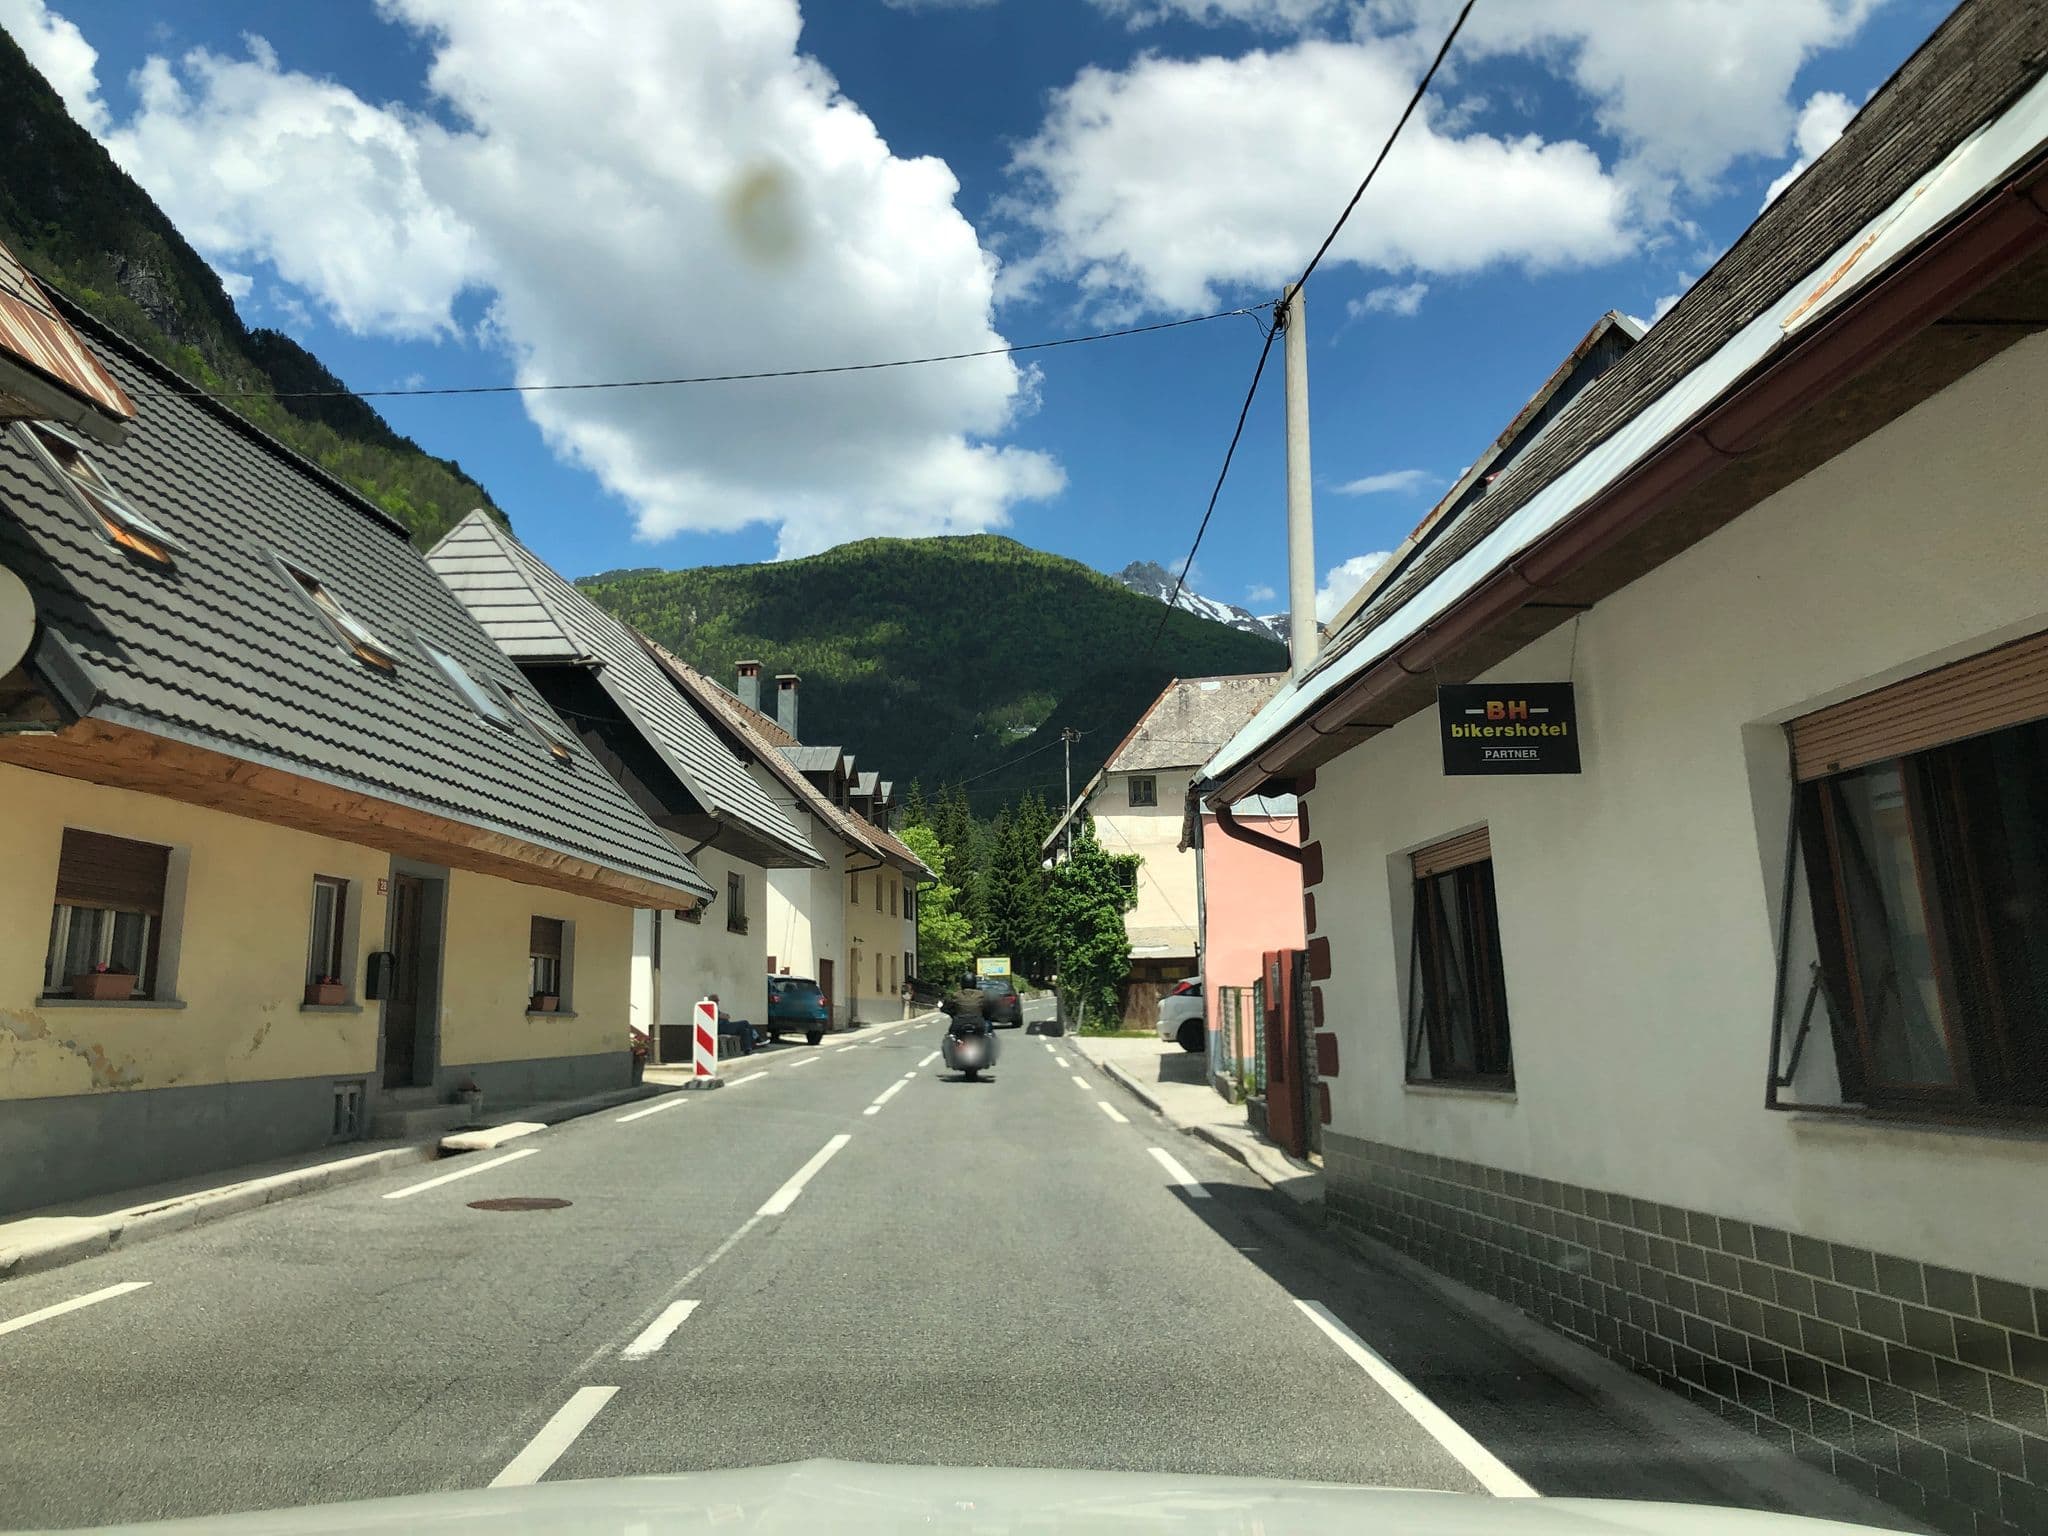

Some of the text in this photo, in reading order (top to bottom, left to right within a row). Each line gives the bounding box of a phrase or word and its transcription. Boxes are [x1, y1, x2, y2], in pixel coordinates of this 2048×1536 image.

[1486, 700, 1529, 720] BH
[1451, 721, 1567, 738] bikershotel
[1485, 749, 1537, 759] PARTNER
